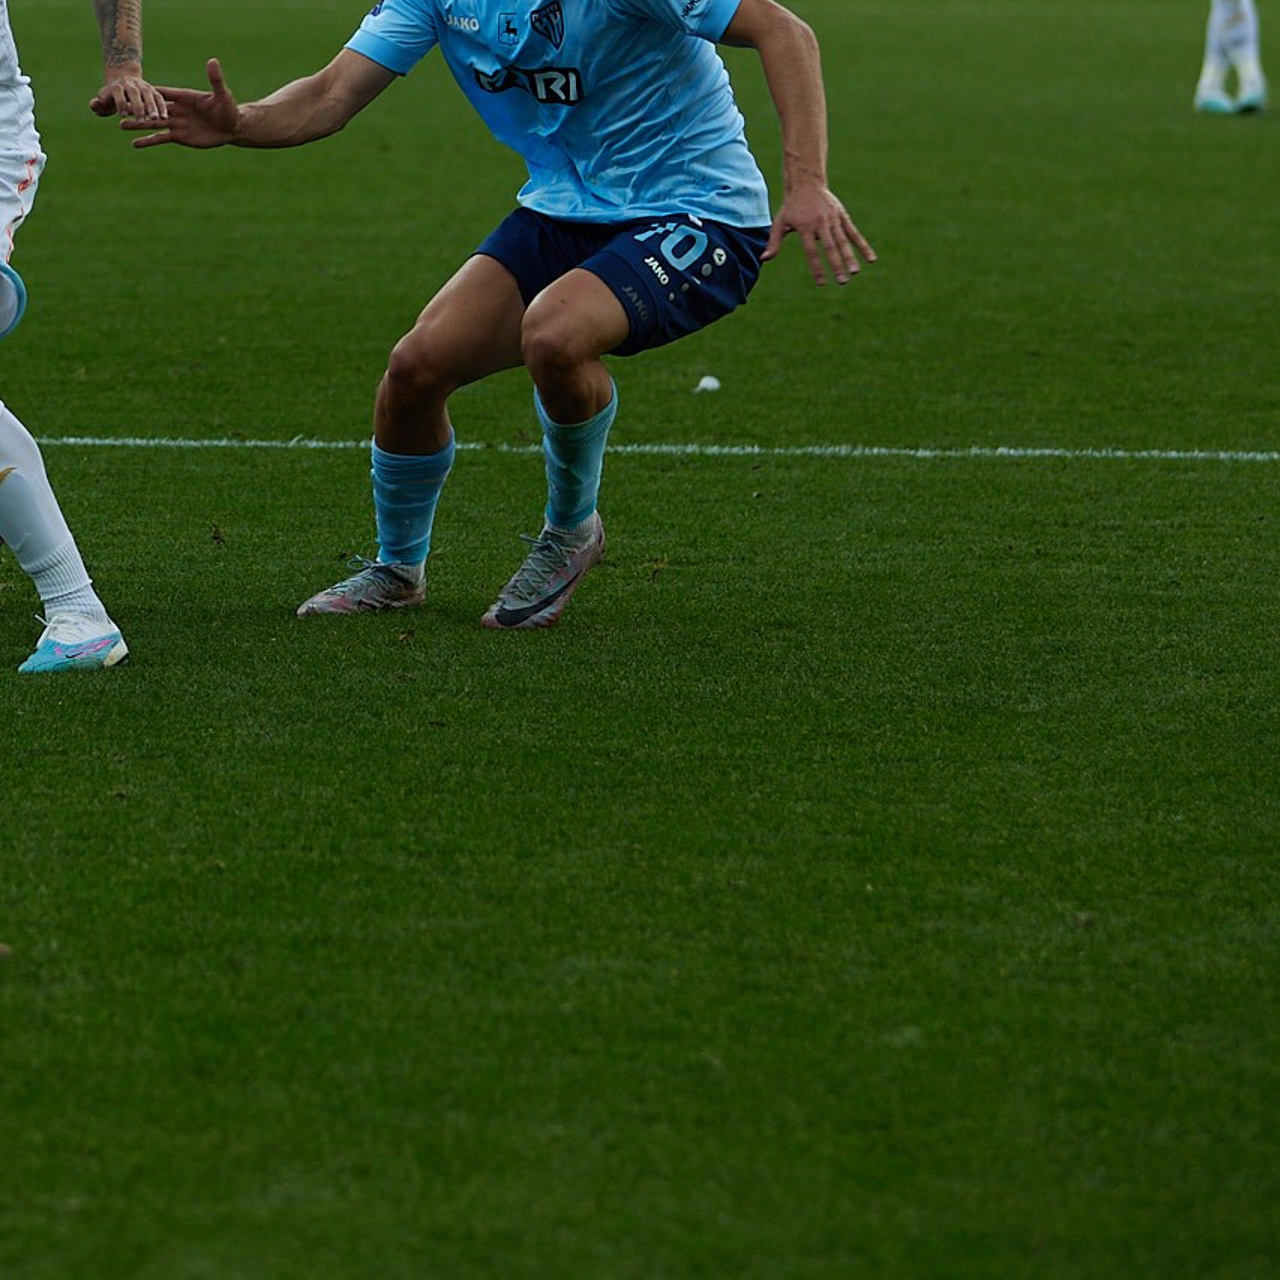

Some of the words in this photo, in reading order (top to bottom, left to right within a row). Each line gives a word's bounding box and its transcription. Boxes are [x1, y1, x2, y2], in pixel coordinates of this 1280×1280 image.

[447, 14, 480, 31] JAKO
[644, 256, 670, 286] JAKO
[622, 285, 649, 321] JAKO
